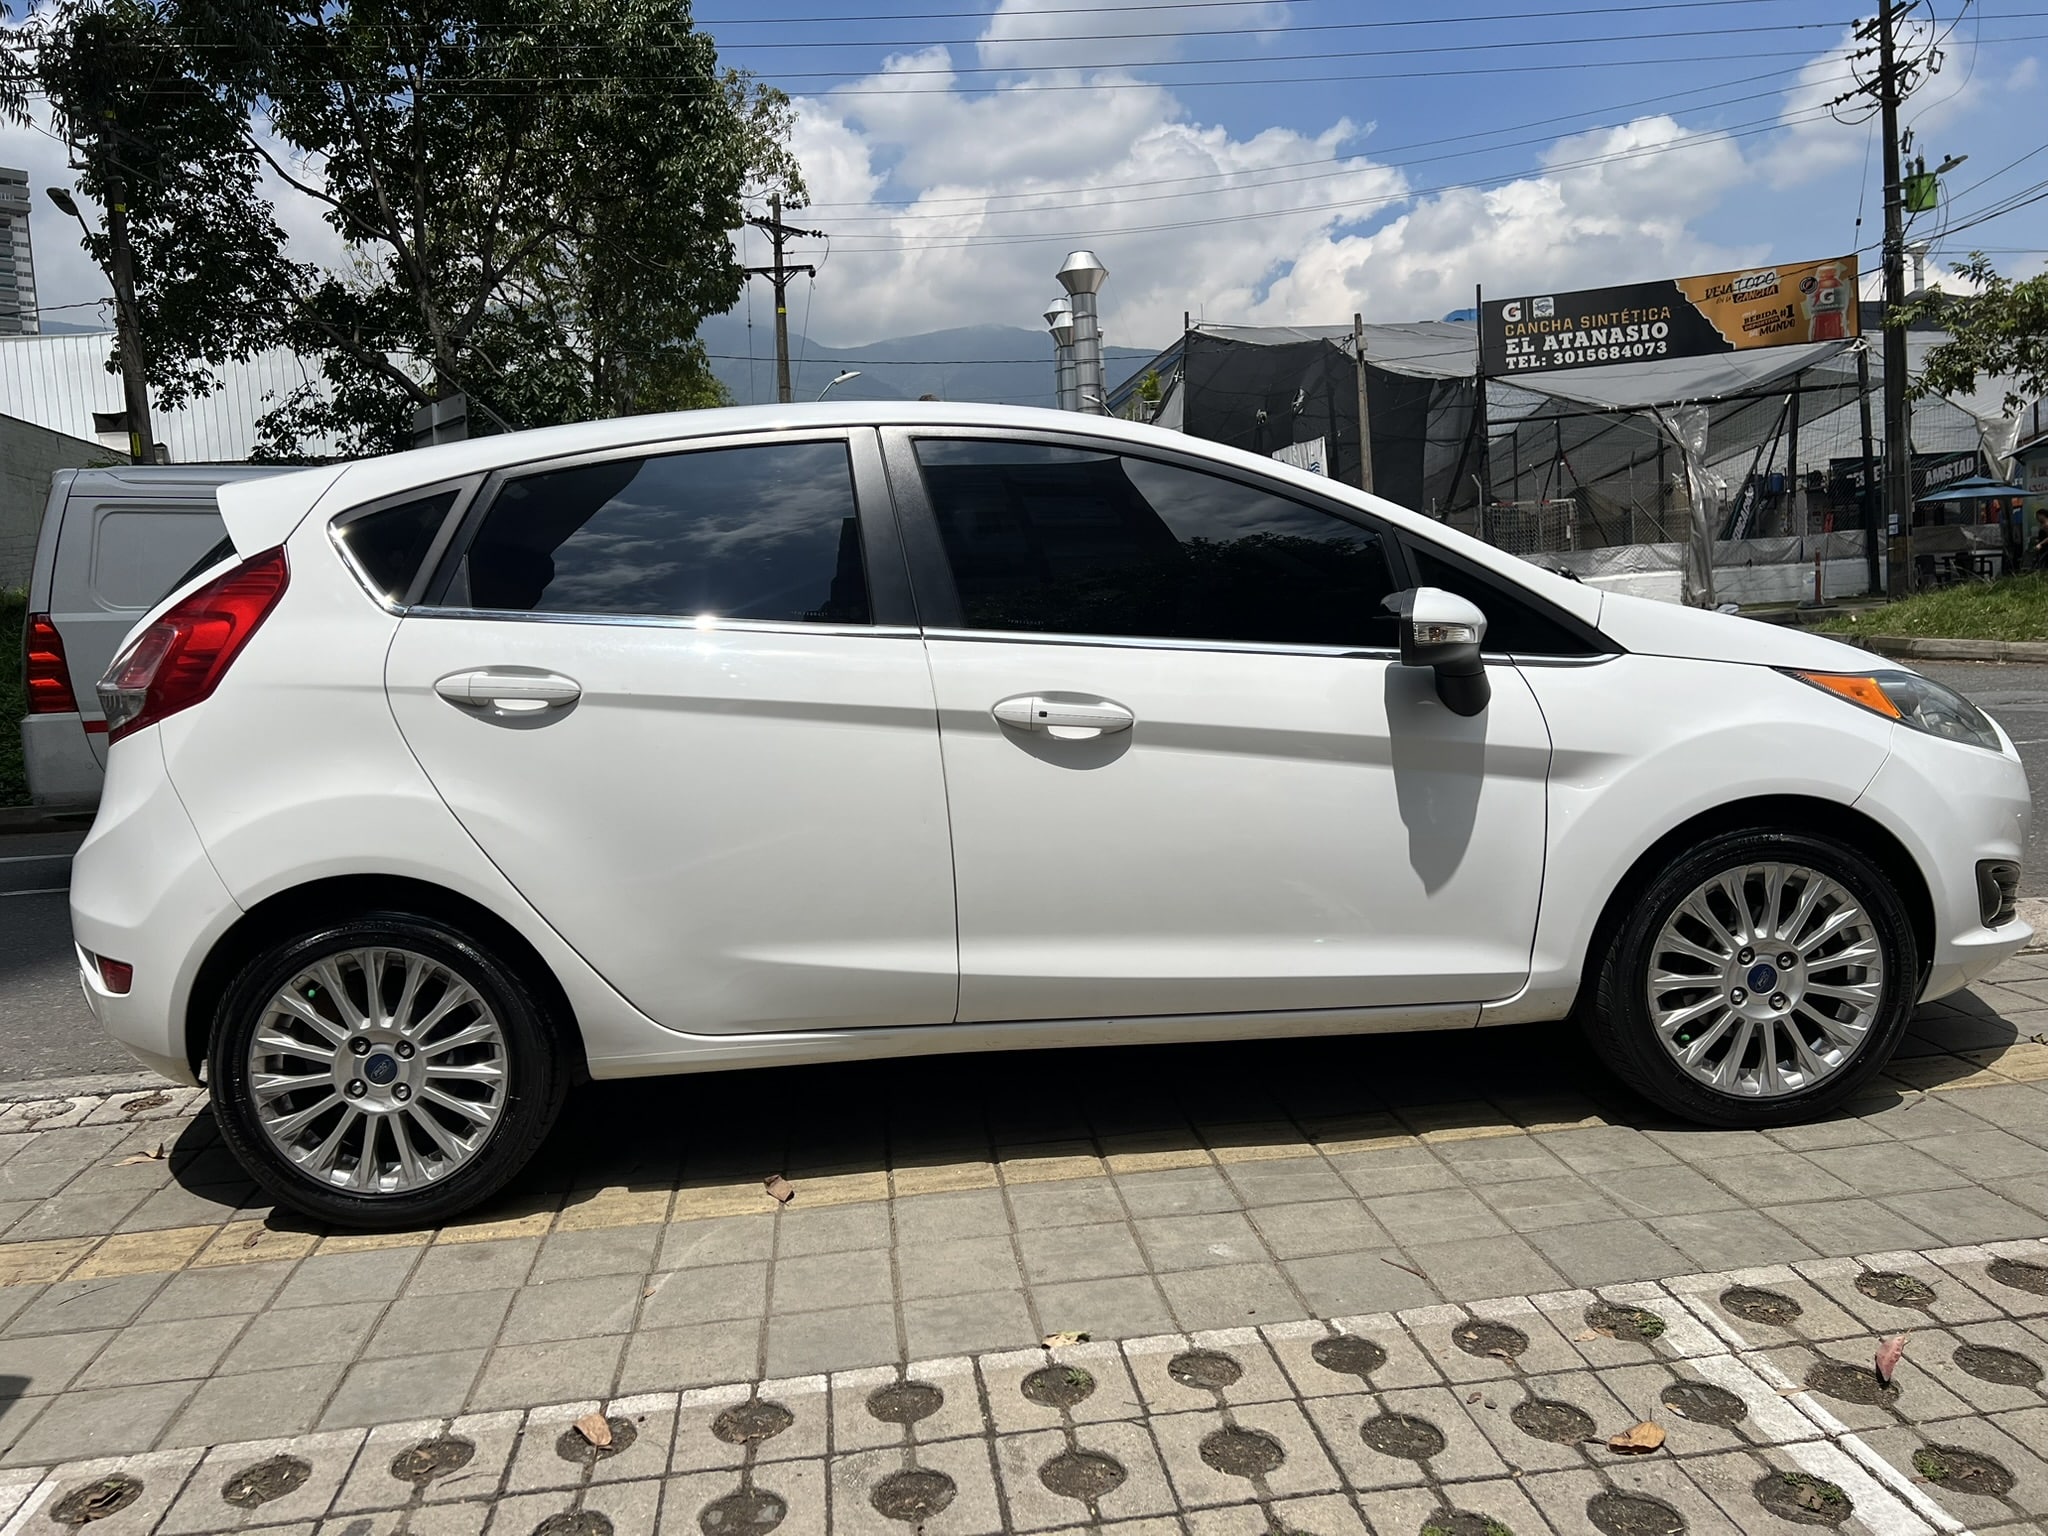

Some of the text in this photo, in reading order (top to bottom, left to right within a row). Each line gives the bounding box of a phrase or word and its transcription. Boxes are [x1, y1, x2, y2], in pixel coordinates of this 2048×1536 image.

[1505, 306, 1671, 337] CANCHA SINTÉTICA
[1759, 318, 1796, 336] MUNDO
[1505, 322, 1669, 355] EL ATANASIO
[1505, 341, 1668, 369] TEL: 3015684073
[1924, 457, 1975, 487] AMISTAD
